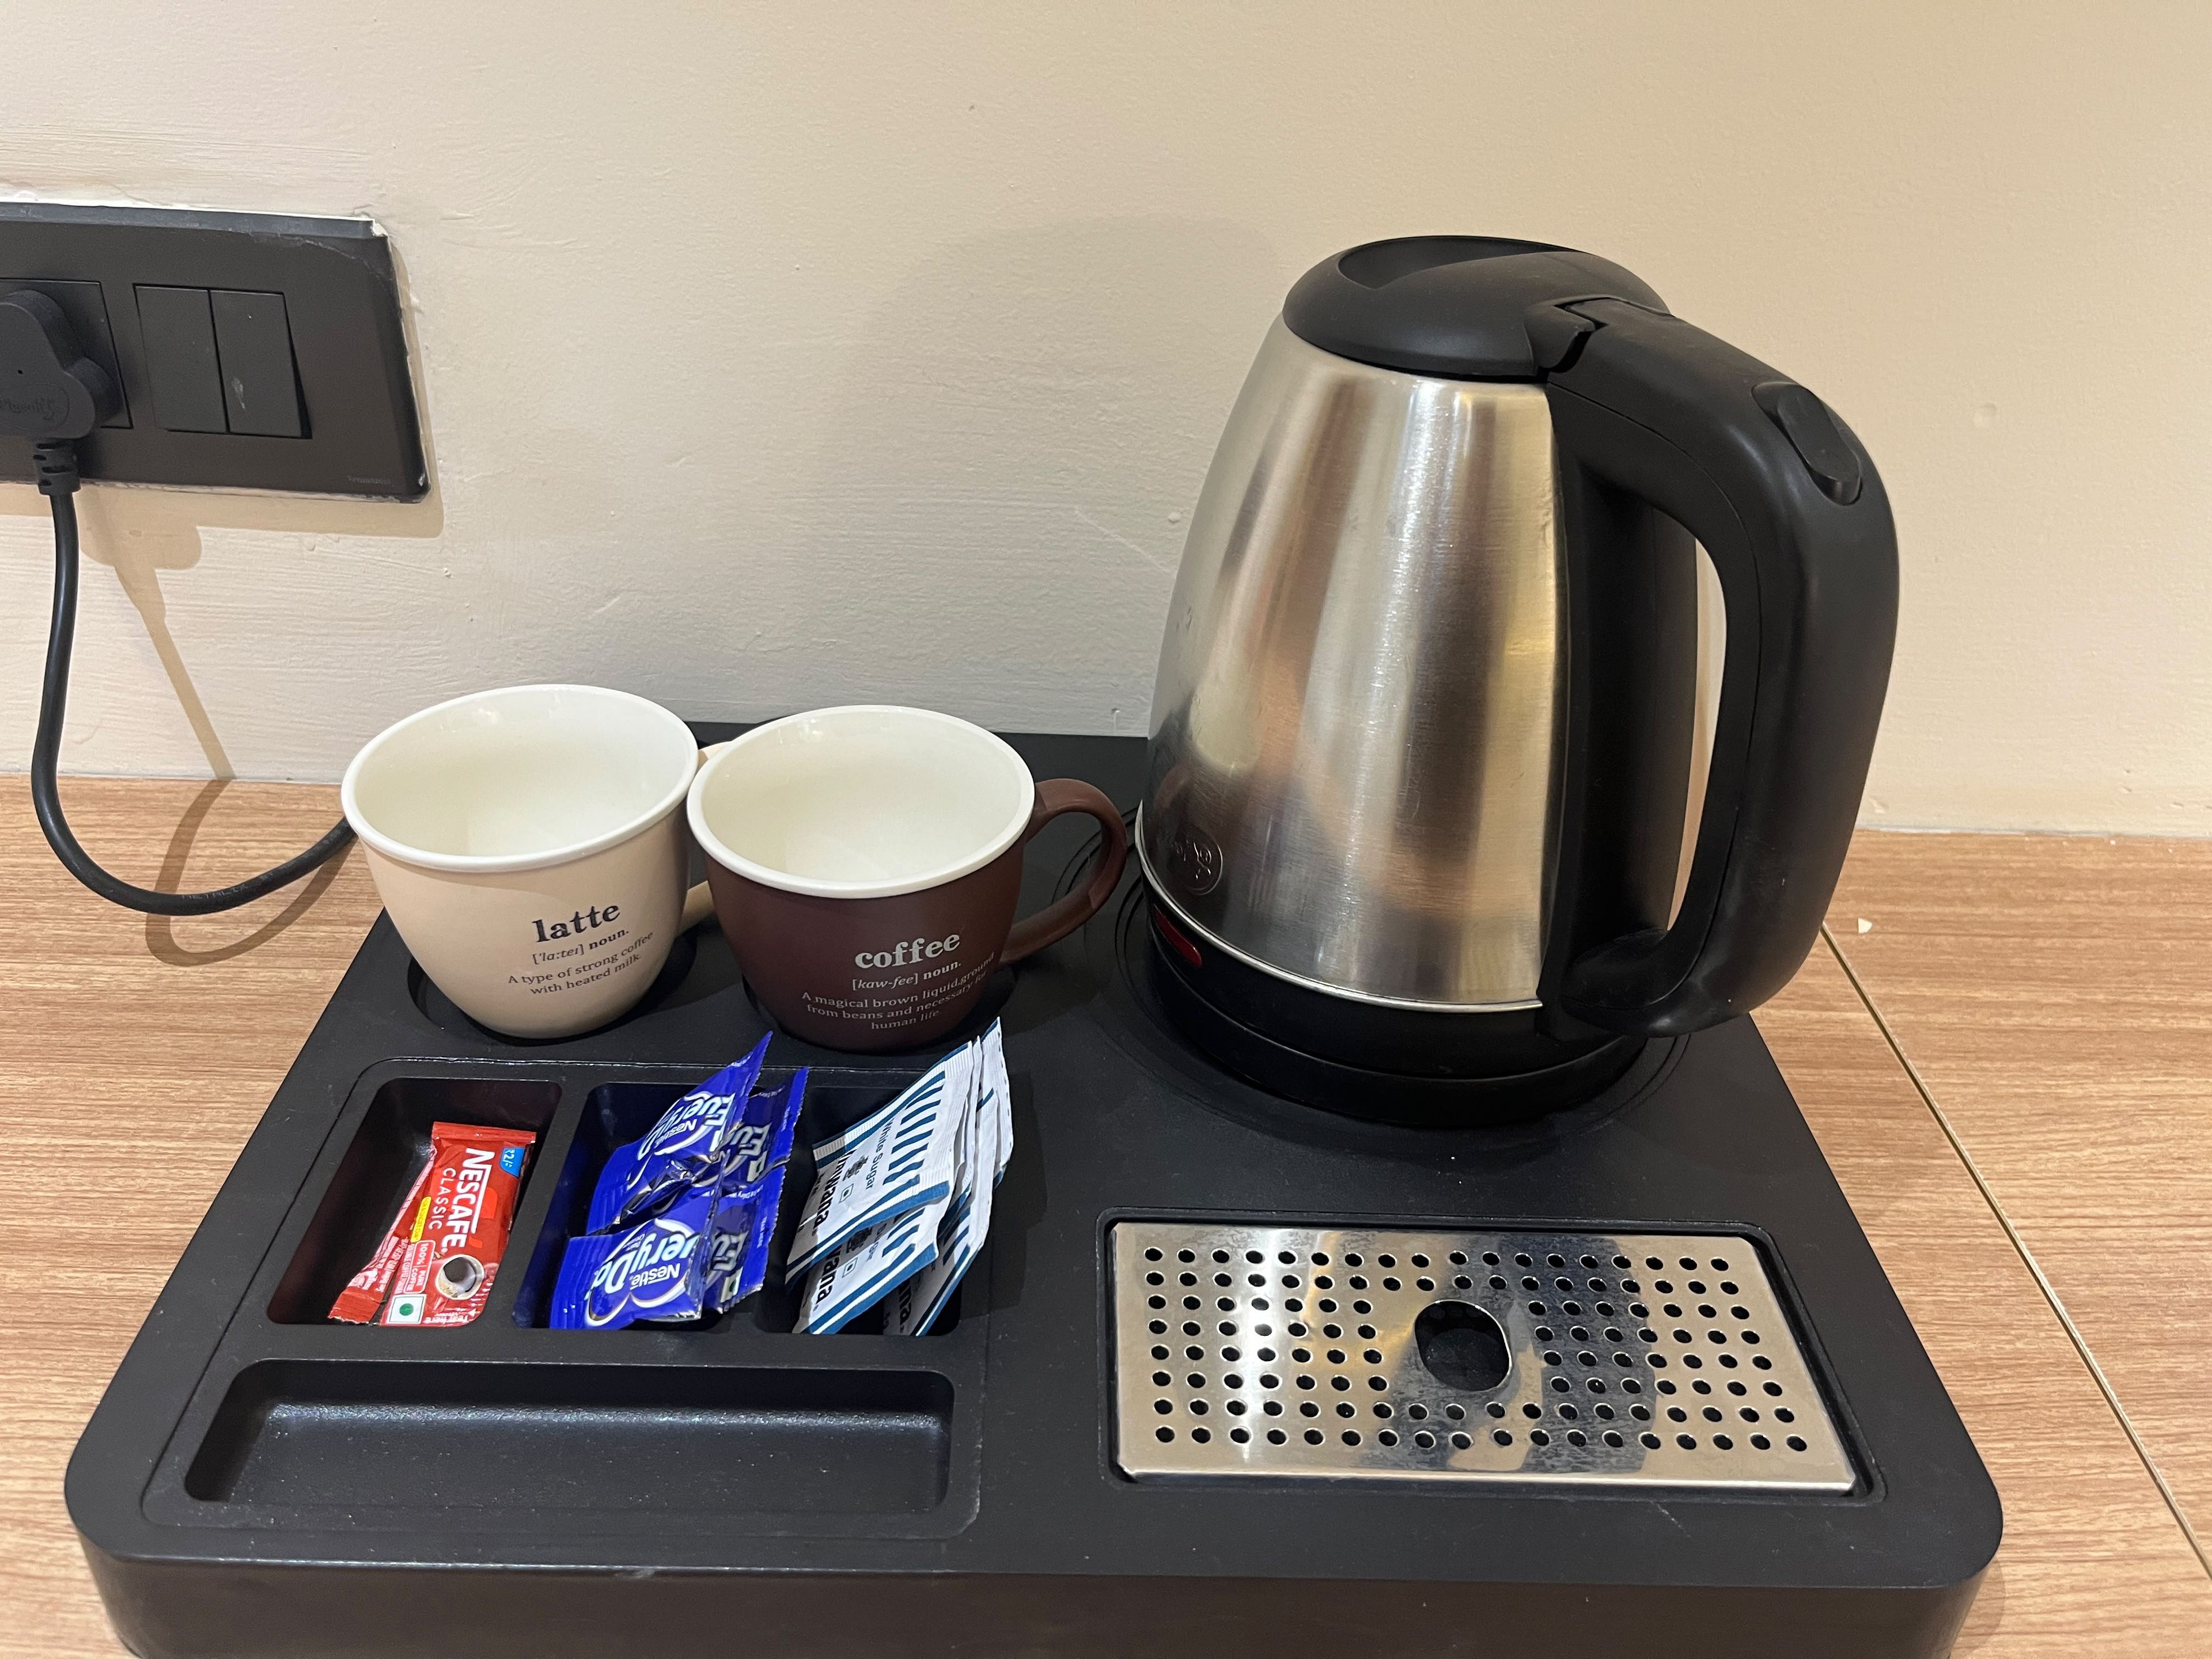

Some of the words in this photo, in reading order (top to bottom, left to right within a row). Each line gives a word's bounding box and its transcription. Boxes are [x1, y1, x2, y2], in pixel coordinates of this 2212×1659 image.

[532, 905, 620, 942] latte
[589, 929, 629, 950] noun.
[521, 974, 553, 986] type
[558, 967, 572, 978] of
[575, 953, 618, 975] strong
[621, 931, 653, 956] coffee
[855, 934, 960, 969] coffee
[531, 983, 562, 995] with
[567, 968, 611, 989] heated
[852, 973, 918, 991] [kaw-fee]
[923, 961, 961, 980] noun.
[802, 992, 812, 1001] A
[815, 996, 868, 1008] magical
[873, 995, 918, 1008] brown
[807, 1005, 838, 1017] from
[842, 1010, 883, 1019] beans
[887, 1006, 912, 1017] and
[916, 981, 974, 1012] necessary
[871, 1017, 916, 1029] human
[876, 1118, 894, 1153] White
[865, 1150, 881, 1190] Sugar
[429, 1168, 456, 1229] CLASSIC
[413, 1243, 427, 1266] 100%
